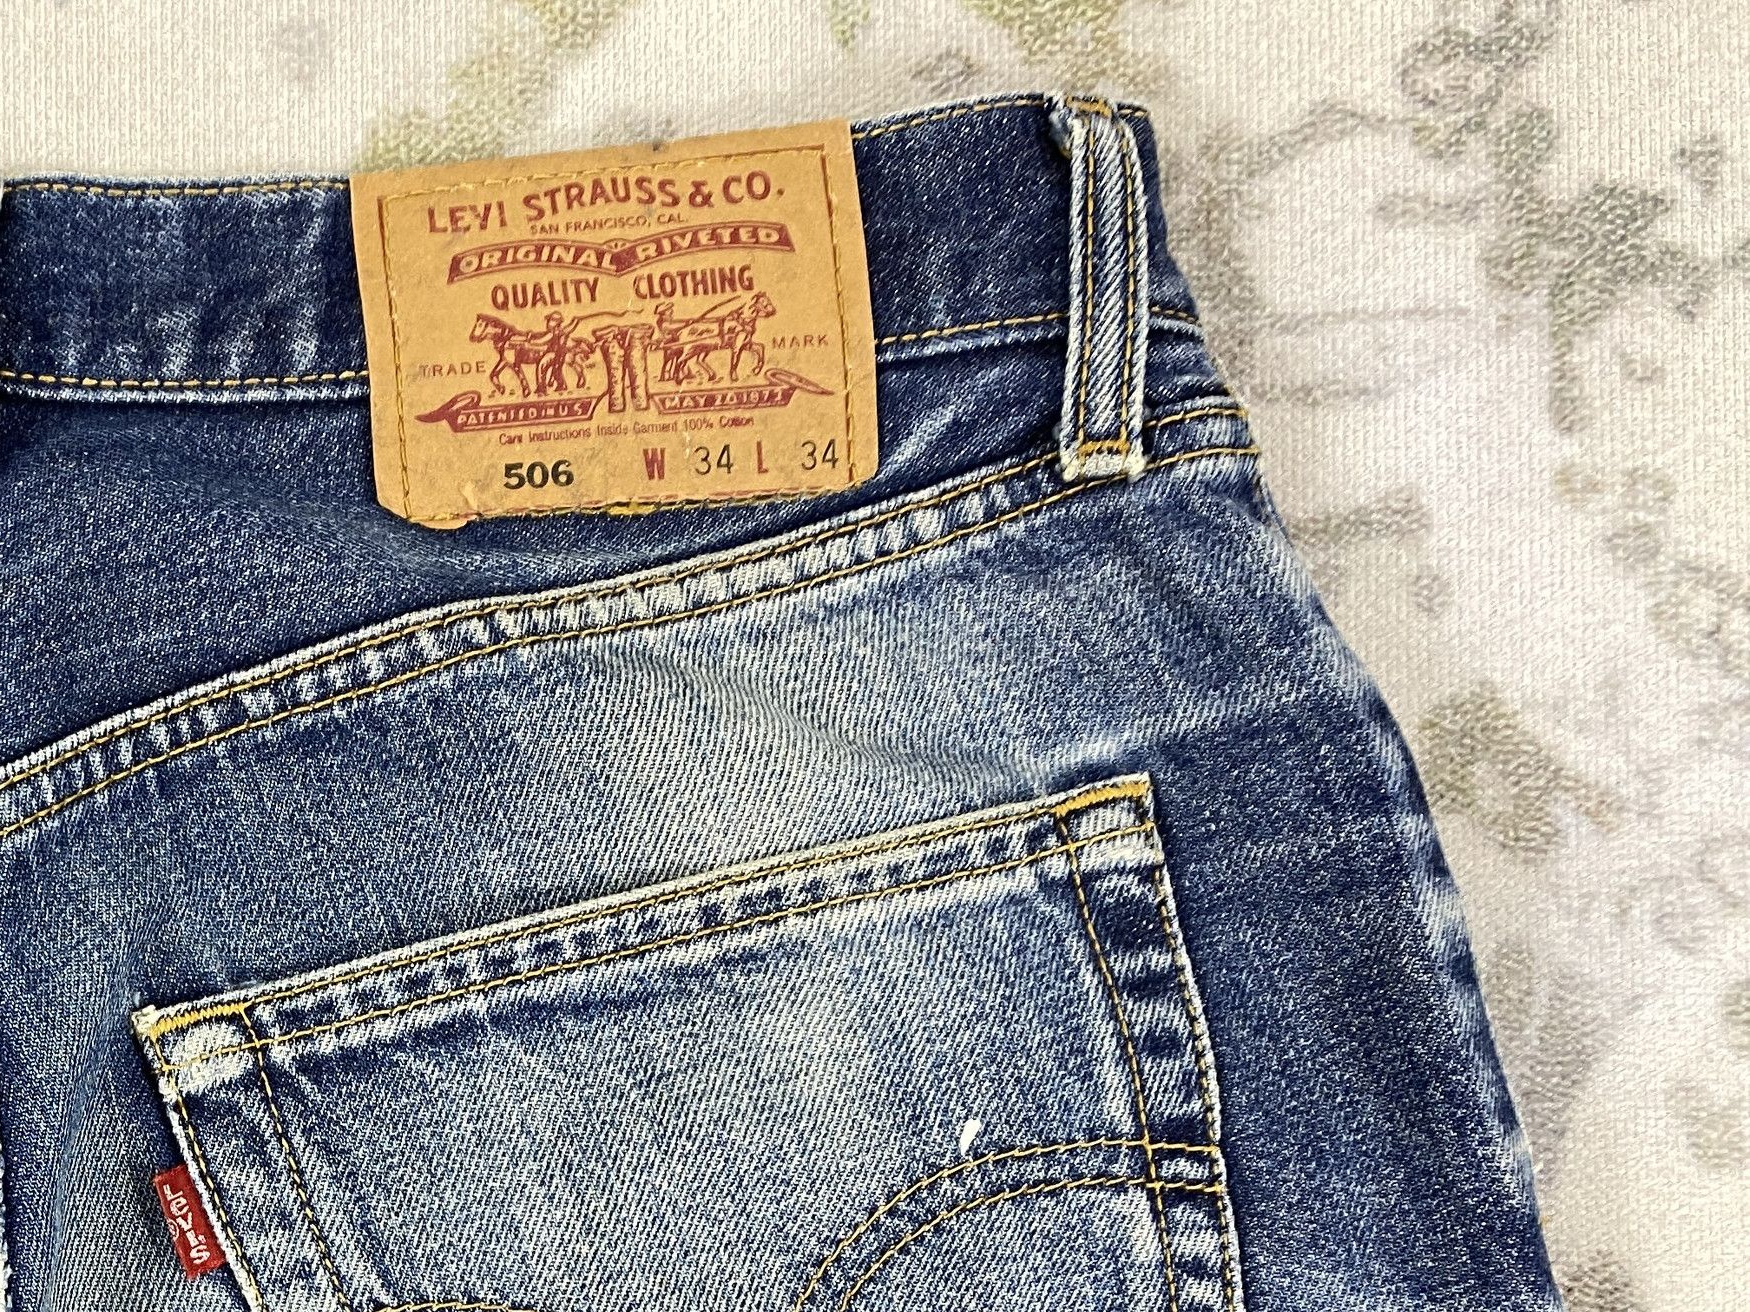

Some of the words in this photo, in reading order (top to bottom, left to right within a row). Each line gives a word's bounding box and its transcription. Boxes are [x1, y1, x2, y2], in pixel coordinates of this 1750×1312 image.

[428, 201, 507, 233] LEVI
[522, 176, 681, 223] STRAUSS
[688, 180, 714, 208] &
[722, 170, 786, 204] CO.
[459, 245, 617, 273] ORIGINAL
[636, 227, 780, 261] RIVETED
[530, 224, 559, 235] SAN
[491, 277, 599, 311] QUALITY
[633, 264, 755, 299] CLOTHING
[419, 361, 486, 377] TRADE
[772, 334, 829, 349] MARK
[664, 394, 707, 409] MAY
[529, 427, 592, 443] Instructions
[597, 423, 628, 436] Inside
[683, 418, 714, 431] 100%
[503, 459, 575, 490] 506
[643, 448, 666, 481] W
[693, 444, 734, 476] 34
[756, 440, 769, 474] L
[801, 439, 839, 471] 34
